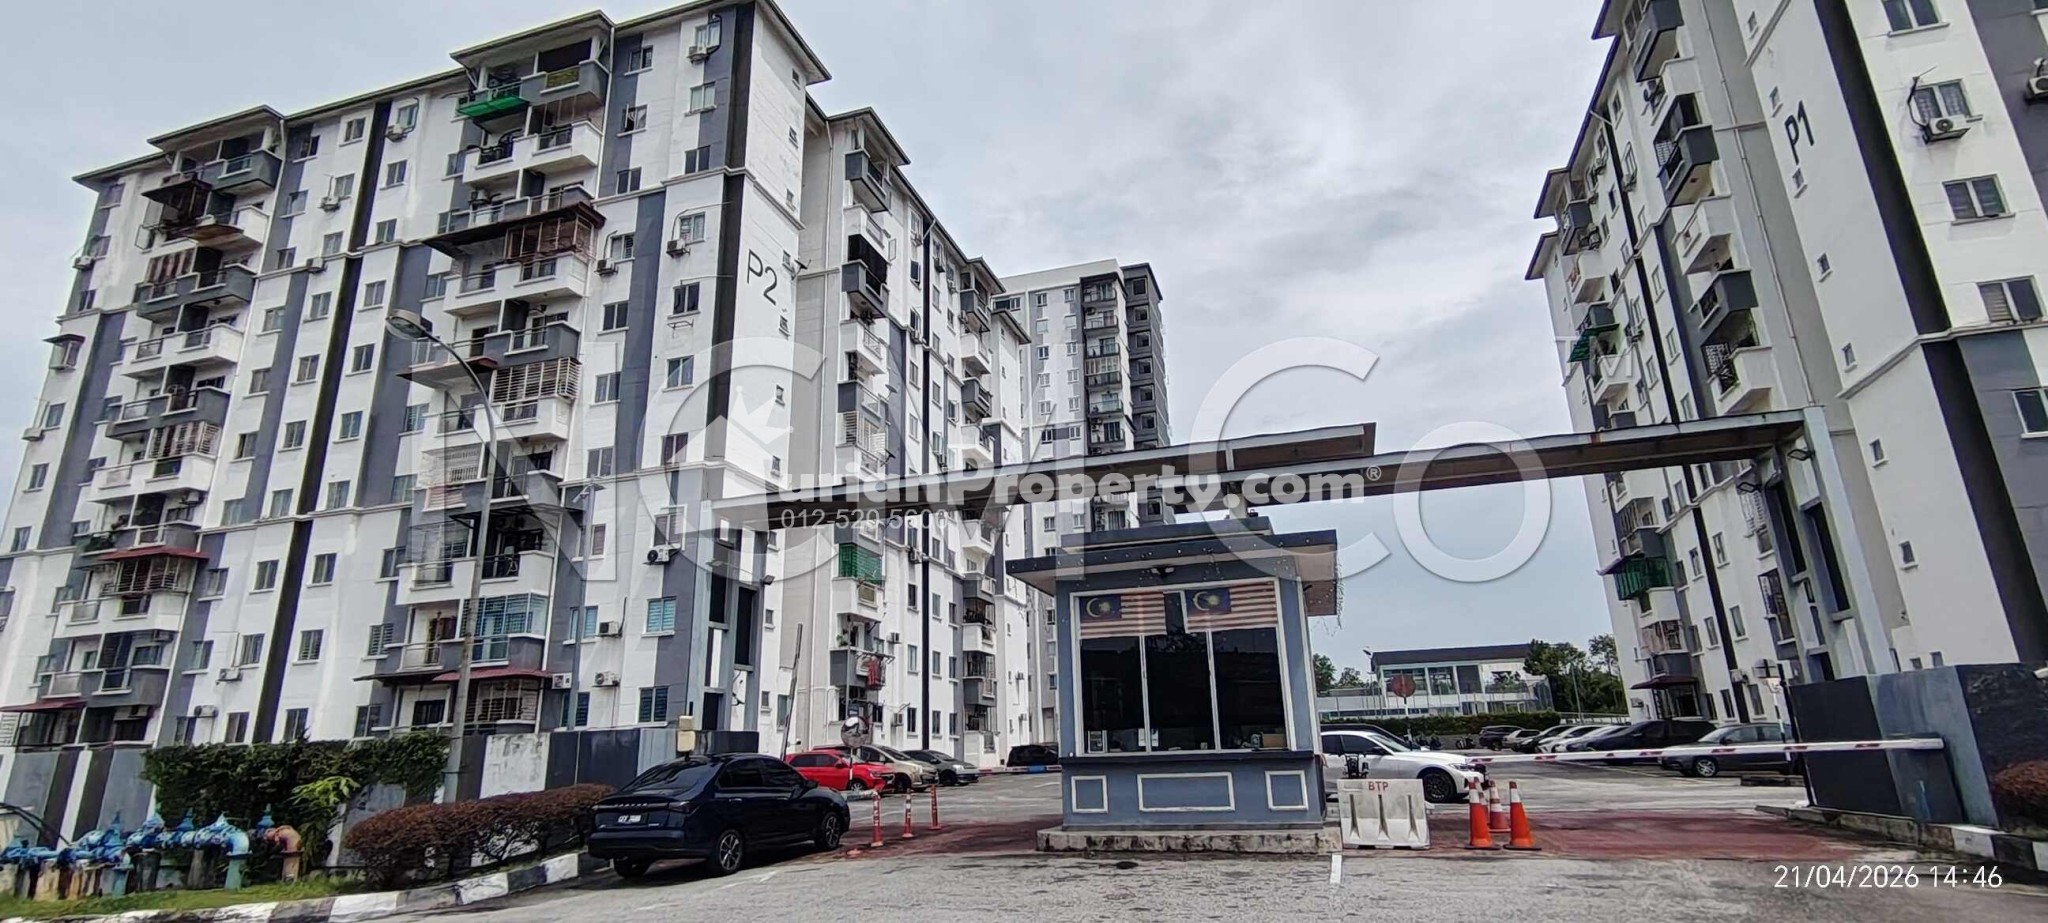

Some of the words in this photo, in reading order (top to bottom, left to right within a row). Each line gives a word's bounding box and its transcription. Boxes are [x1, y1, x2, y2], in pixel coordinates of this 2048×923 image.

[1784, 100, 1815, 166] P1
[746, 248, 777, 306] P2
[1368, 780, 1389, 792] BTP
